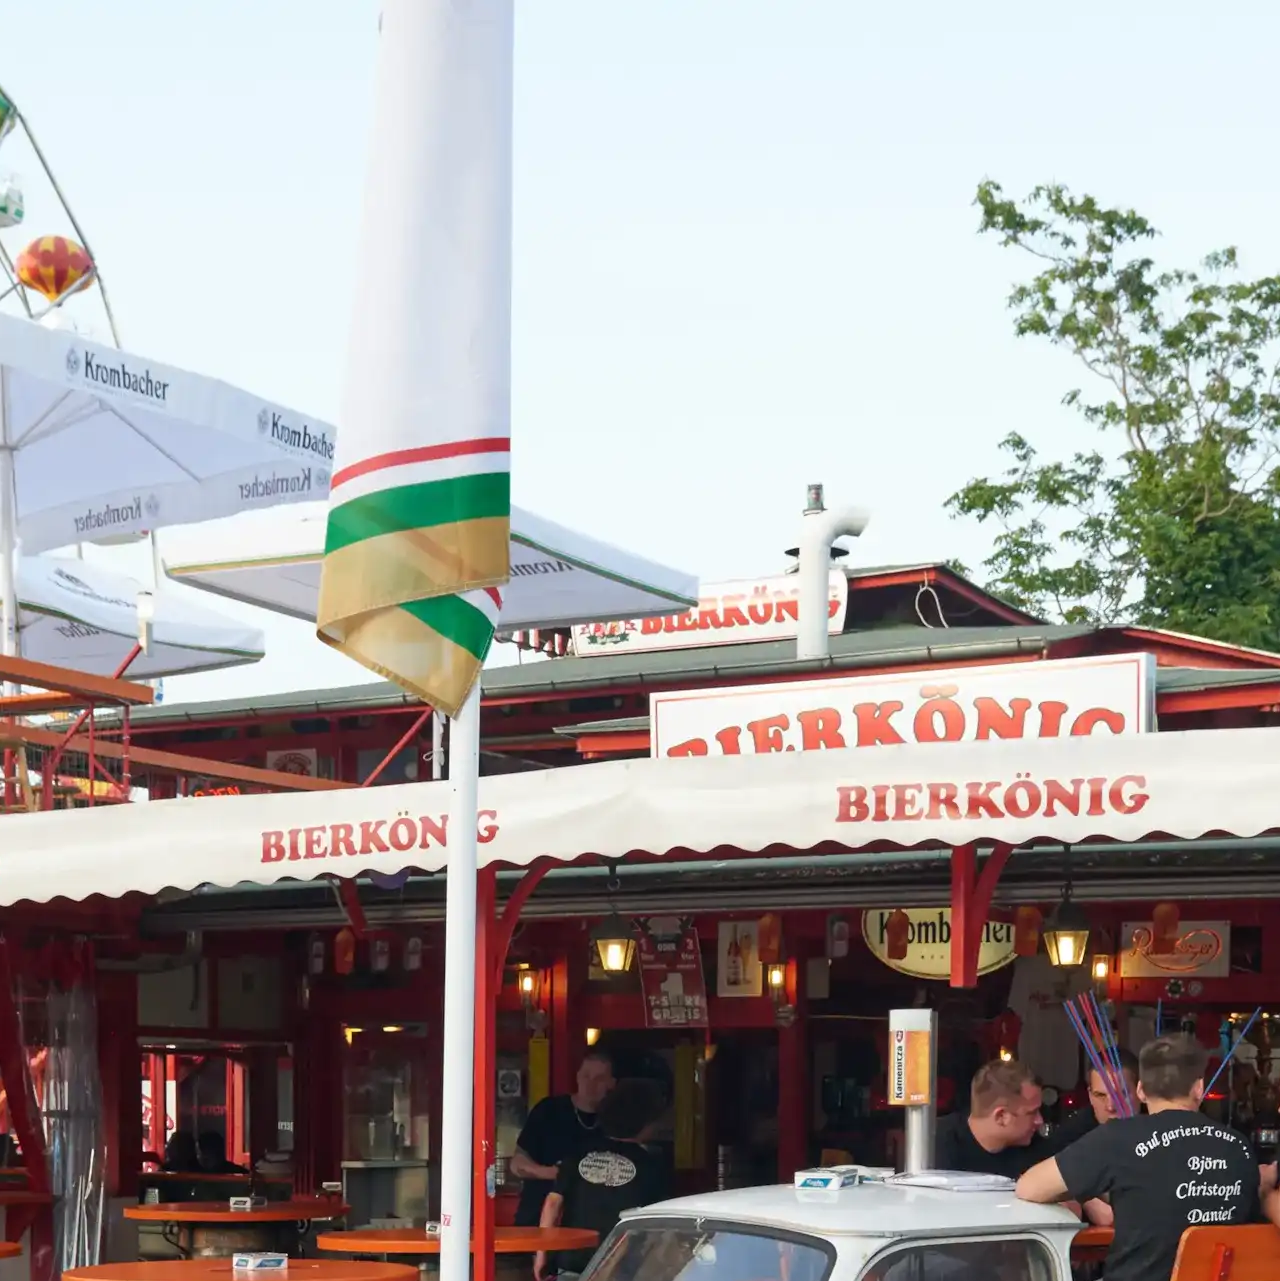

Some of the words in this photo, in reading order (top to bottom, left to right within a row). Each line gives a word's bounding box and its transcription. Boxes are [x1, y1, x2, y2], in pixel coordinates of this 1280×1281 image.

[84, 350, 169, 401] Krombacher
[640, 586, 842, 636] BIERKÖN
[835, 772, 1151, 824] BIERKÖNIG
[260, 810, 501, 864] BIERKÖNG
[1187, 1155, 1228, 1175] Björn
[1175, 1180, 1242, 1201] Christoph
[1186, 1205, 1237, 1224] Daniel
